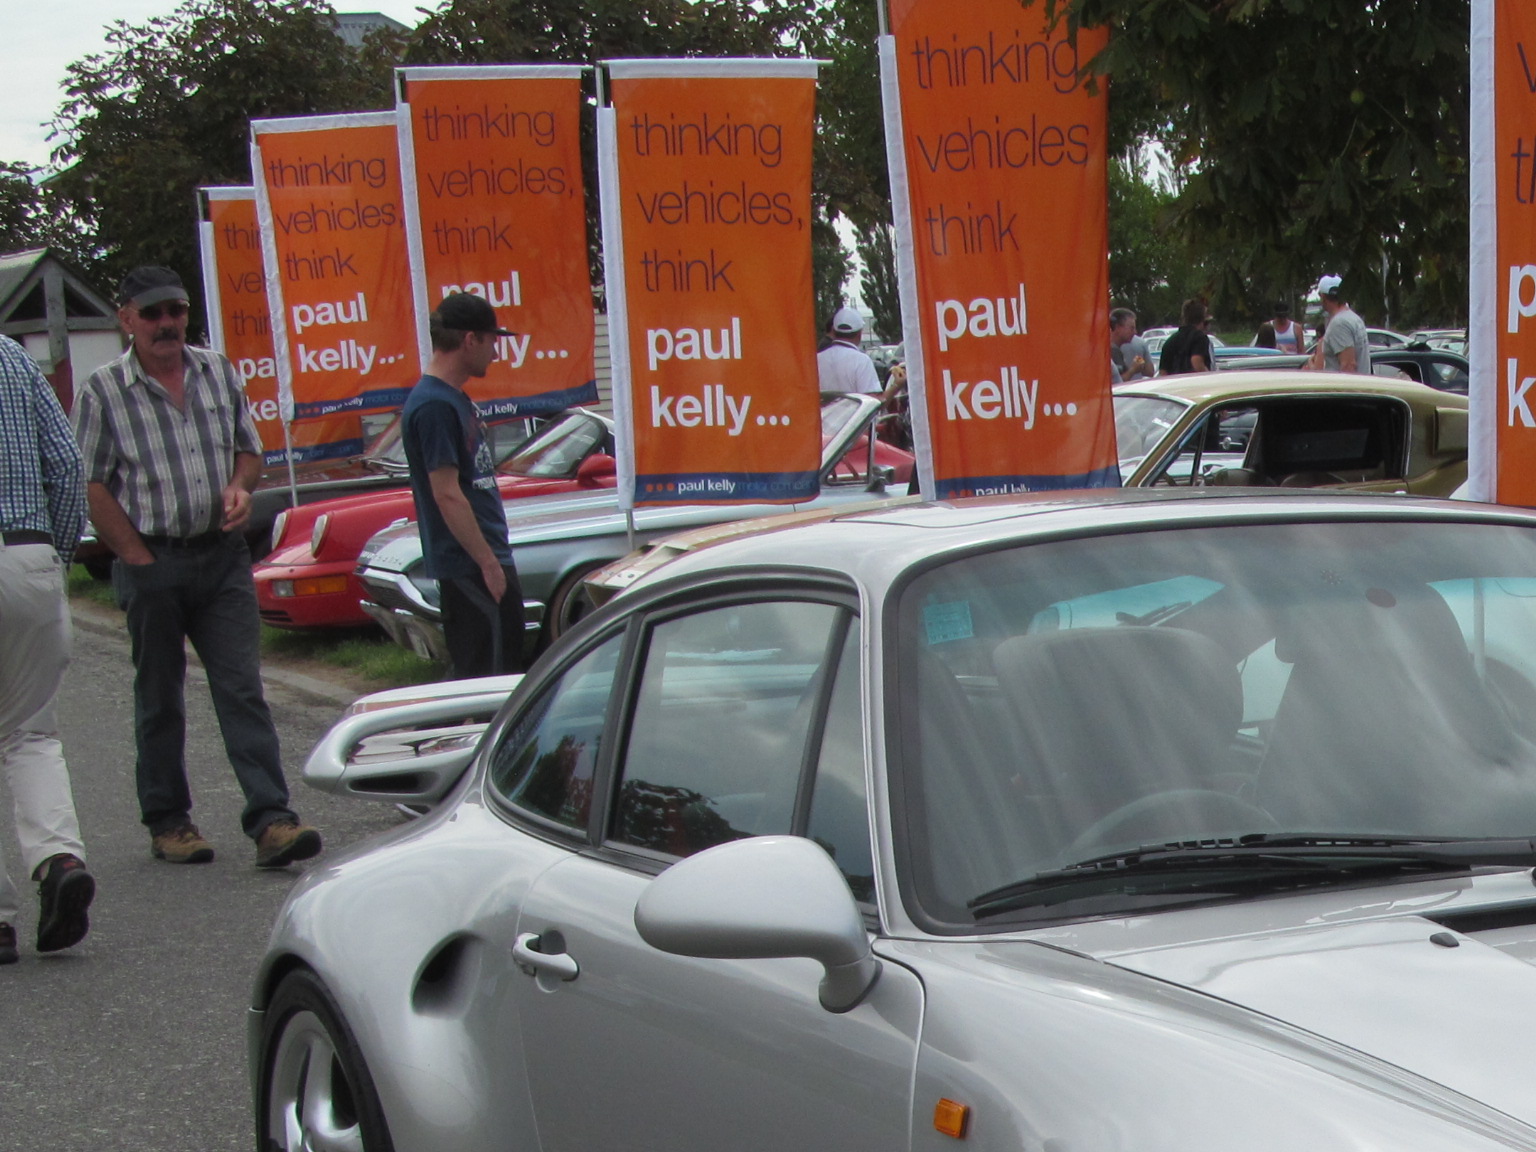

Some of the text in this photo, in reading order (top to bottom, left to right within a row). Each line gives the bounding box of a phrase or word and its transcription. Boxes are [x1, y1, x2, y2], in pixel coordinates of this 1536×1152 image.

[912, 29, 1081, 94] thinking
[422, 105, 556, 147] thinking
[630, 112, 783, 168] thinking
[268, 153, 387, 190] thinking
[427, 159, 574, 199] vehicles,
[636, 180, 804, 231] vehicles,
[433, 217, 513, 256] think
[925, 200, 1020, 257] think
[285, 247, 358, 281] think
[640, 248, 735, 292] think
[292, 292, 368, 334] paul
[935, 283, 1027, 352] paul
[299, 339, 405, 375] kelly...
[647, 317, 743, 371] paul
[239, 356, 276, 386] pa
[494, 402, 518, 414] kelly
[650, 384, 791, 436] kelly...
[942, 365, 1078, 430] kelly...
[677, 479, 705, 495] paul
[707, 479, 736, 493] kelly
